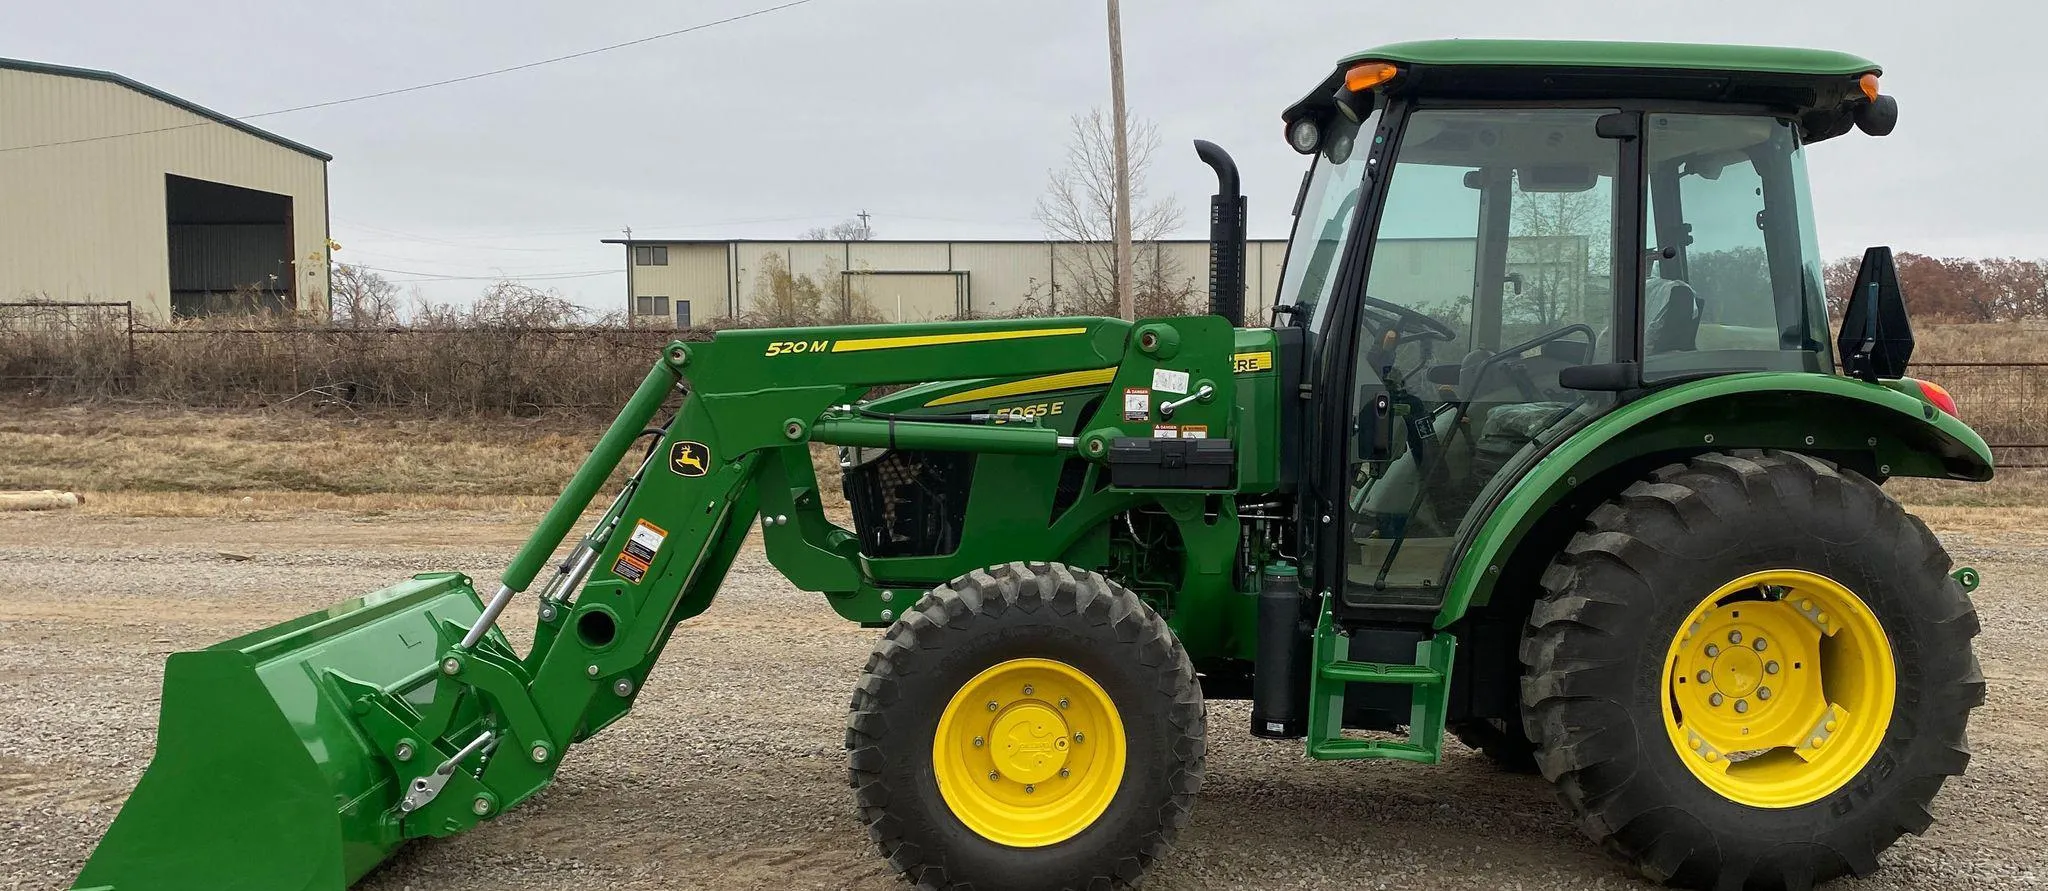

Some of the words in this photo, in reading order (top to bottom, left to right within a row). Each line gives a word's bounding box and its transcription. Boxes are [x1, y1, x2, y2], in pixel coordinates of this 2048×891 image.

[765, 341, 808, 356] 520
[809, 340, 829, 352] M
[1051, 401, 1064, 415] E
